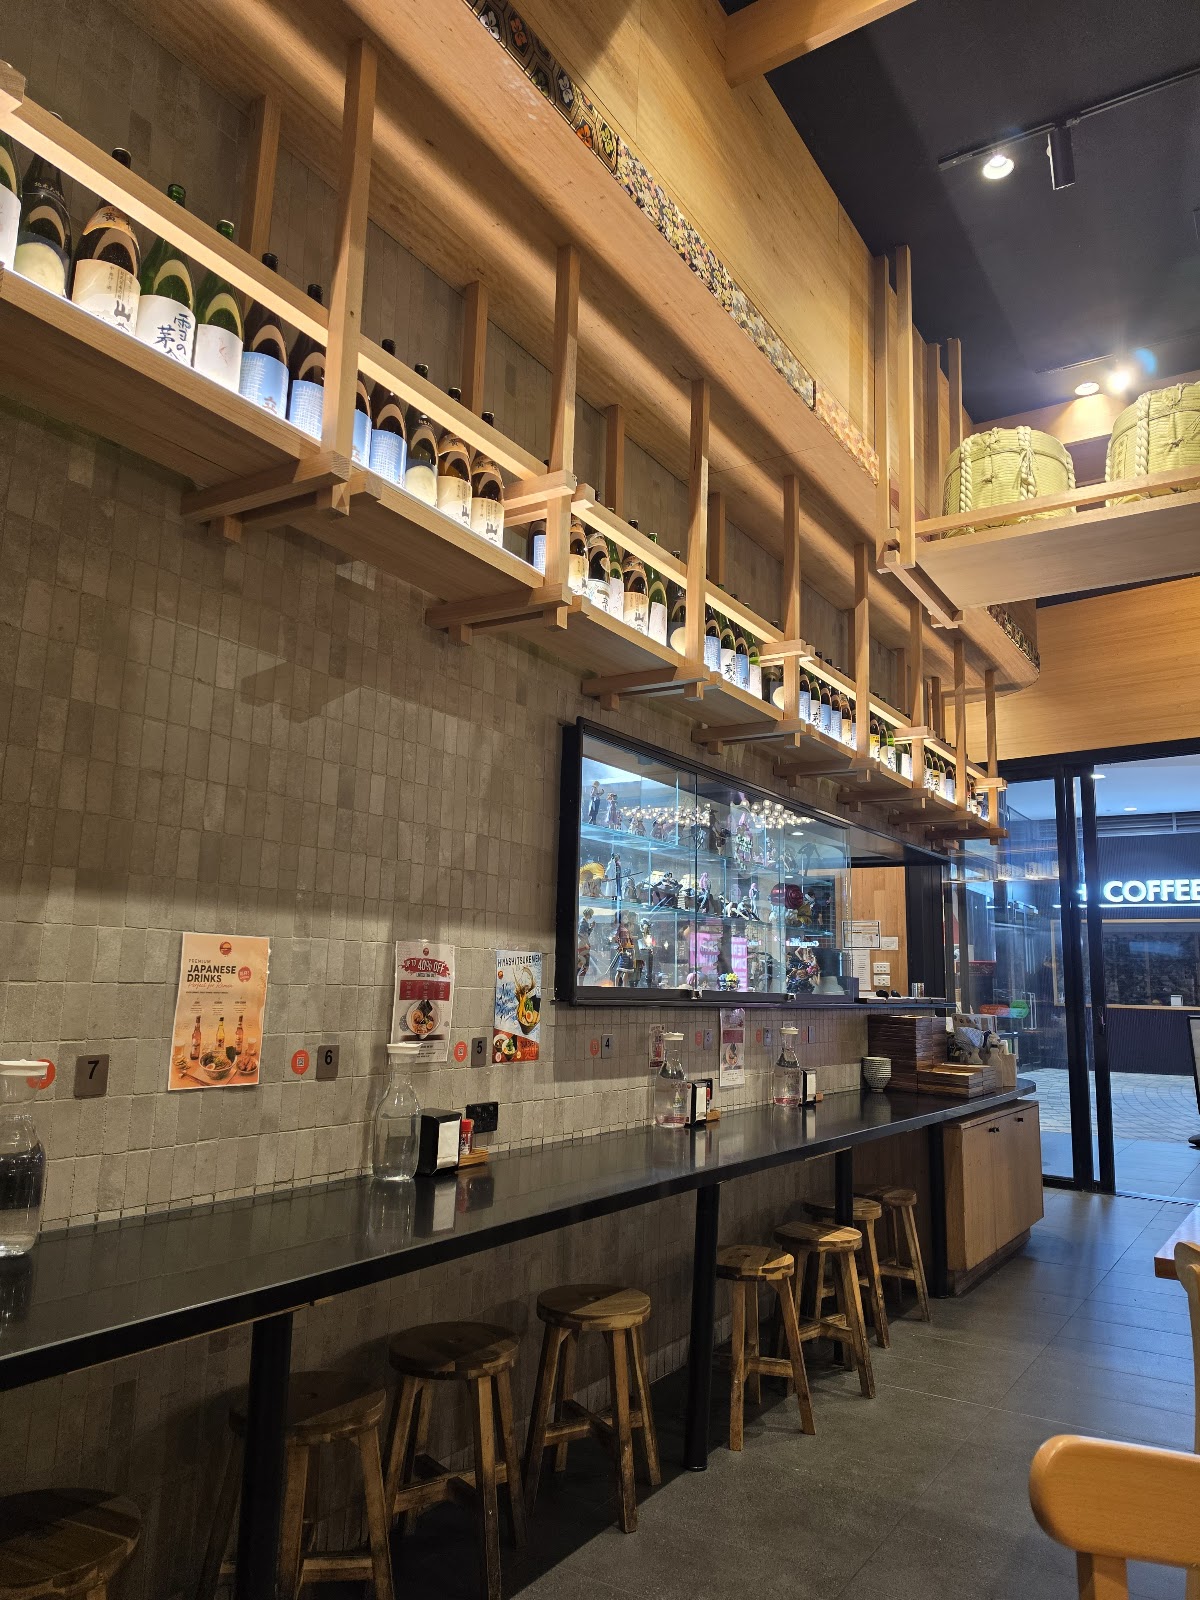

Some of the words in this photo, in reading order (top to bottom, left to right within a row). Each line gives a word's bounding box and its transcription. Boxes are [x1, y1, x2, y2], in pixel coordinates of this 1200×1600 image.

[1103, 879, 1200, 903] COFFEE
[187, 964, 236, 974] JAPANESE
[186, 974, 222, 983] DRINKS
[476, 1040, 483, 1054] 5
[604, 1038, 610, 1050] 4
[324, 1049, 333, 1066] 6
[87, 1060, 100, 1080] 7
